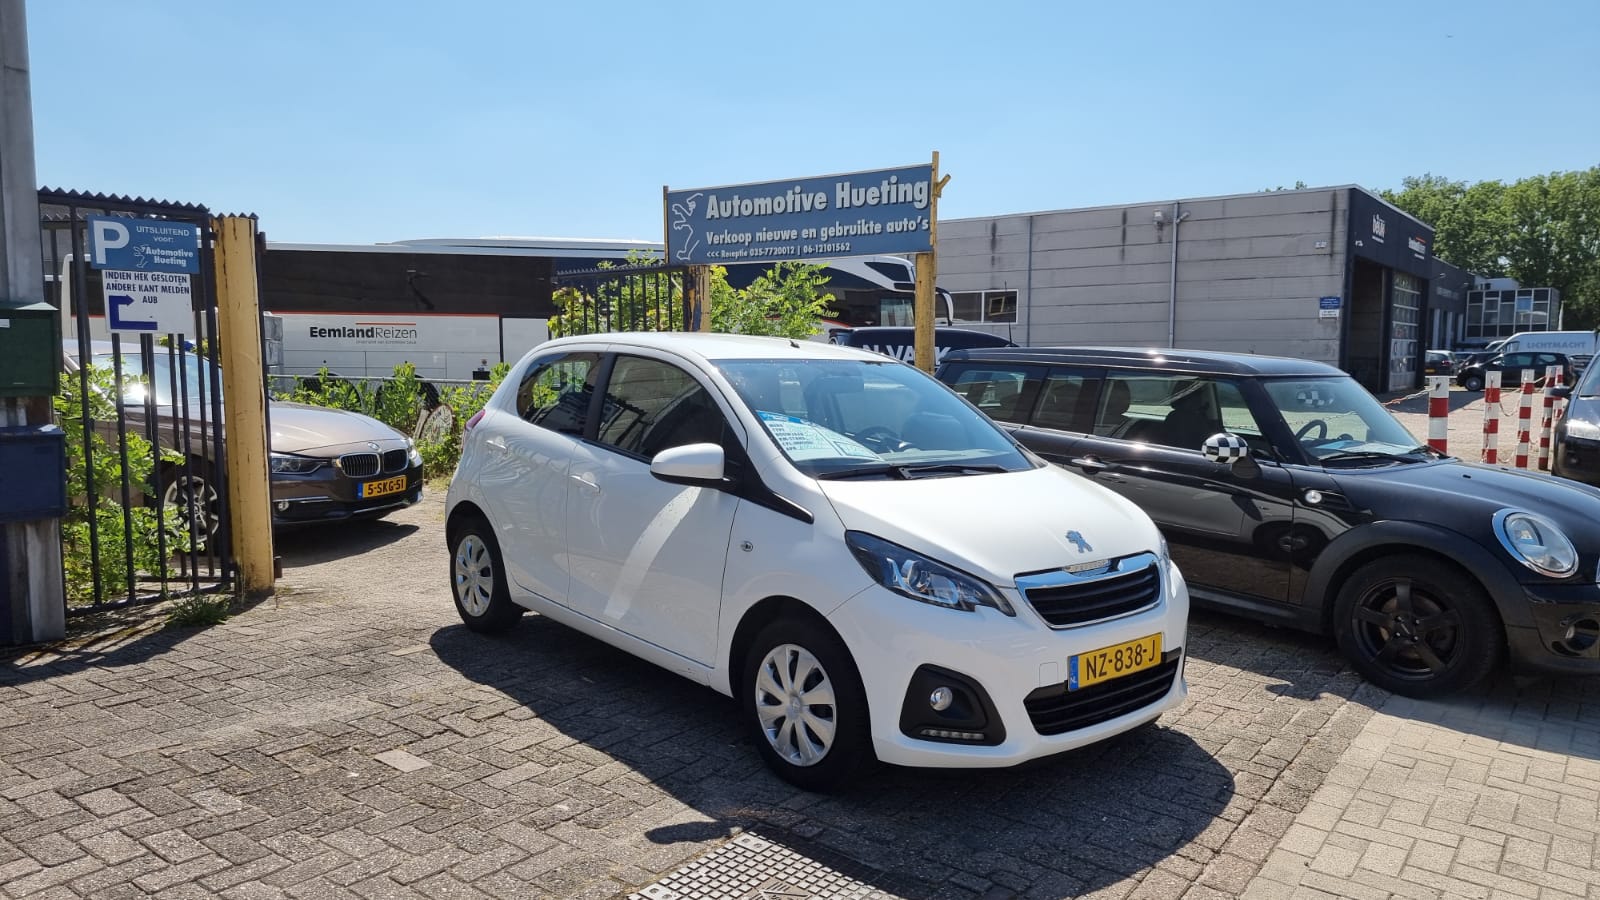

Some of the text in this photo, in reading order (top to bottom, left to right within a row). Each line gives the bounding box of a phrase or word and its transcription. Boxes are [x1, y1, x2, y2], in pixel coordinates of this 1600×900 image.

[706, 175, 930, 220] Automotive Hueting
[136, 225, 190, 237] UITSLUITEND
[706, 215, 930, 247] Verkoop nieuwe en gebruikte auto's
[145, 246, 194, 258] Automotive
[803, 242, 851, 255] 06-12101562
[153, 255, 188, 268] Hueting
[105, 271, 187, 284] INDIEN HEK GESLOTEN
[106, 282, 190, 295] ANDERE KANT MELDEN
[142, 295, 159, 304] AUB
[309, 326, 418, 339] EemlandReizen
[367, 479, 404, 496] 5-SKG-51
[1086, 639, 1156, 681] NZ-838-J
